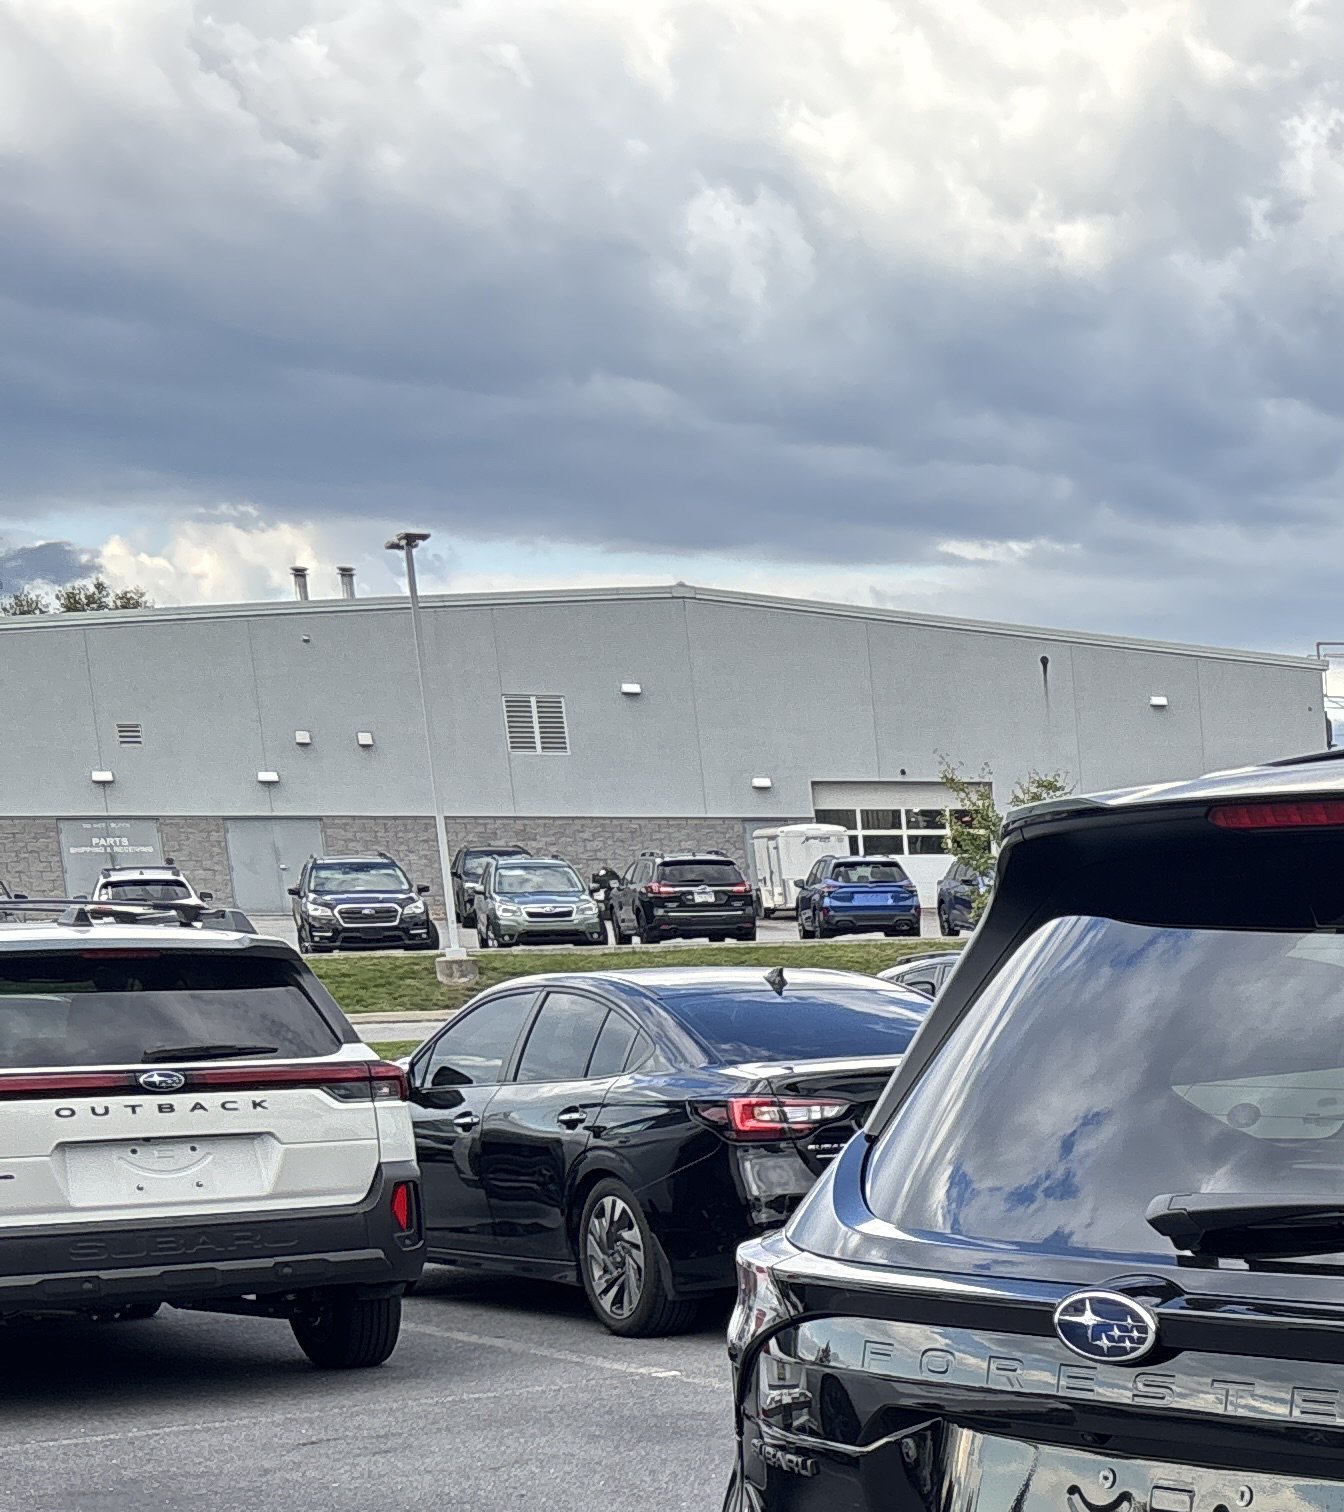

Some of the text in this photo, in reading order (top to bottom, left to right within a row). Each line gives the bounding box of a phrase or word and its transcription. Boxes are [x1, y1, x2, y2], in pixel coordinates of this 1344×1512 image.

[91, 837, 129, 846] PARTS
[54, 1099, 269, 1118] OUTBACK
[750, 1438, 819, 1478] SUBARU
